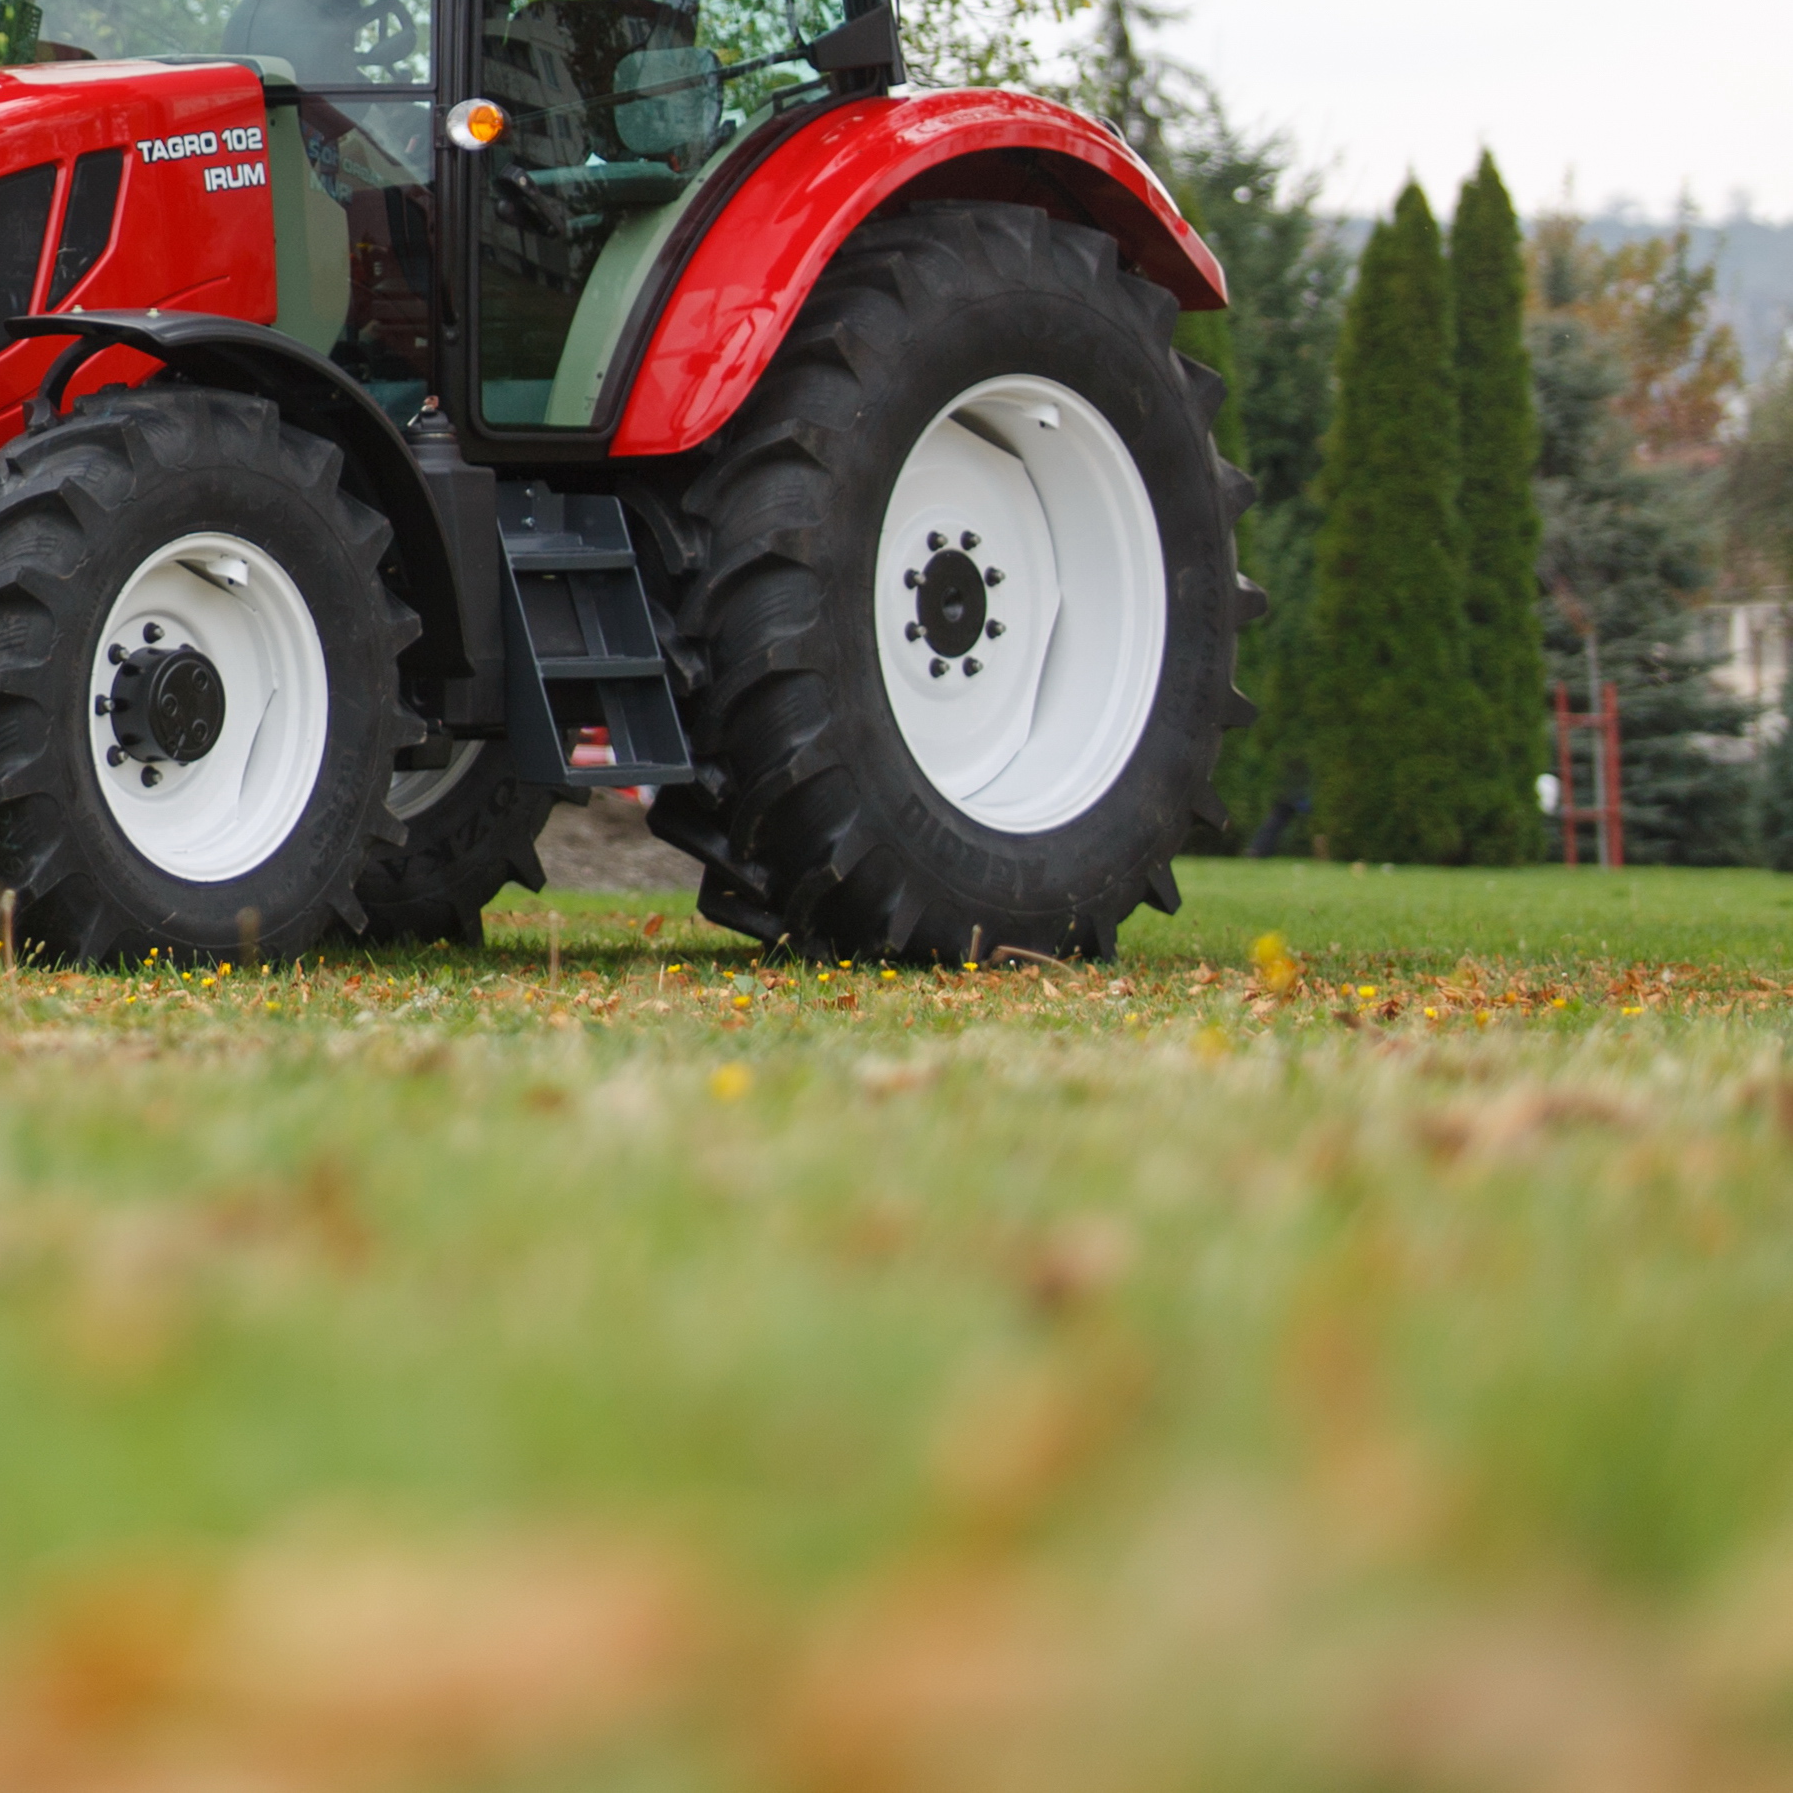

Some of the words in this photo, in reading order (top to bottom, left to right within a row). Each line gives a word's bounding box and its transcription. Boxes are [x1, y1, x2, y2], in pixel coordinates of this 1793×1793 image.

[136, 131, 218, 164] TAGRO
[221, 126, 263, 152] 102
[203, 161, 266, 193] IRUM
